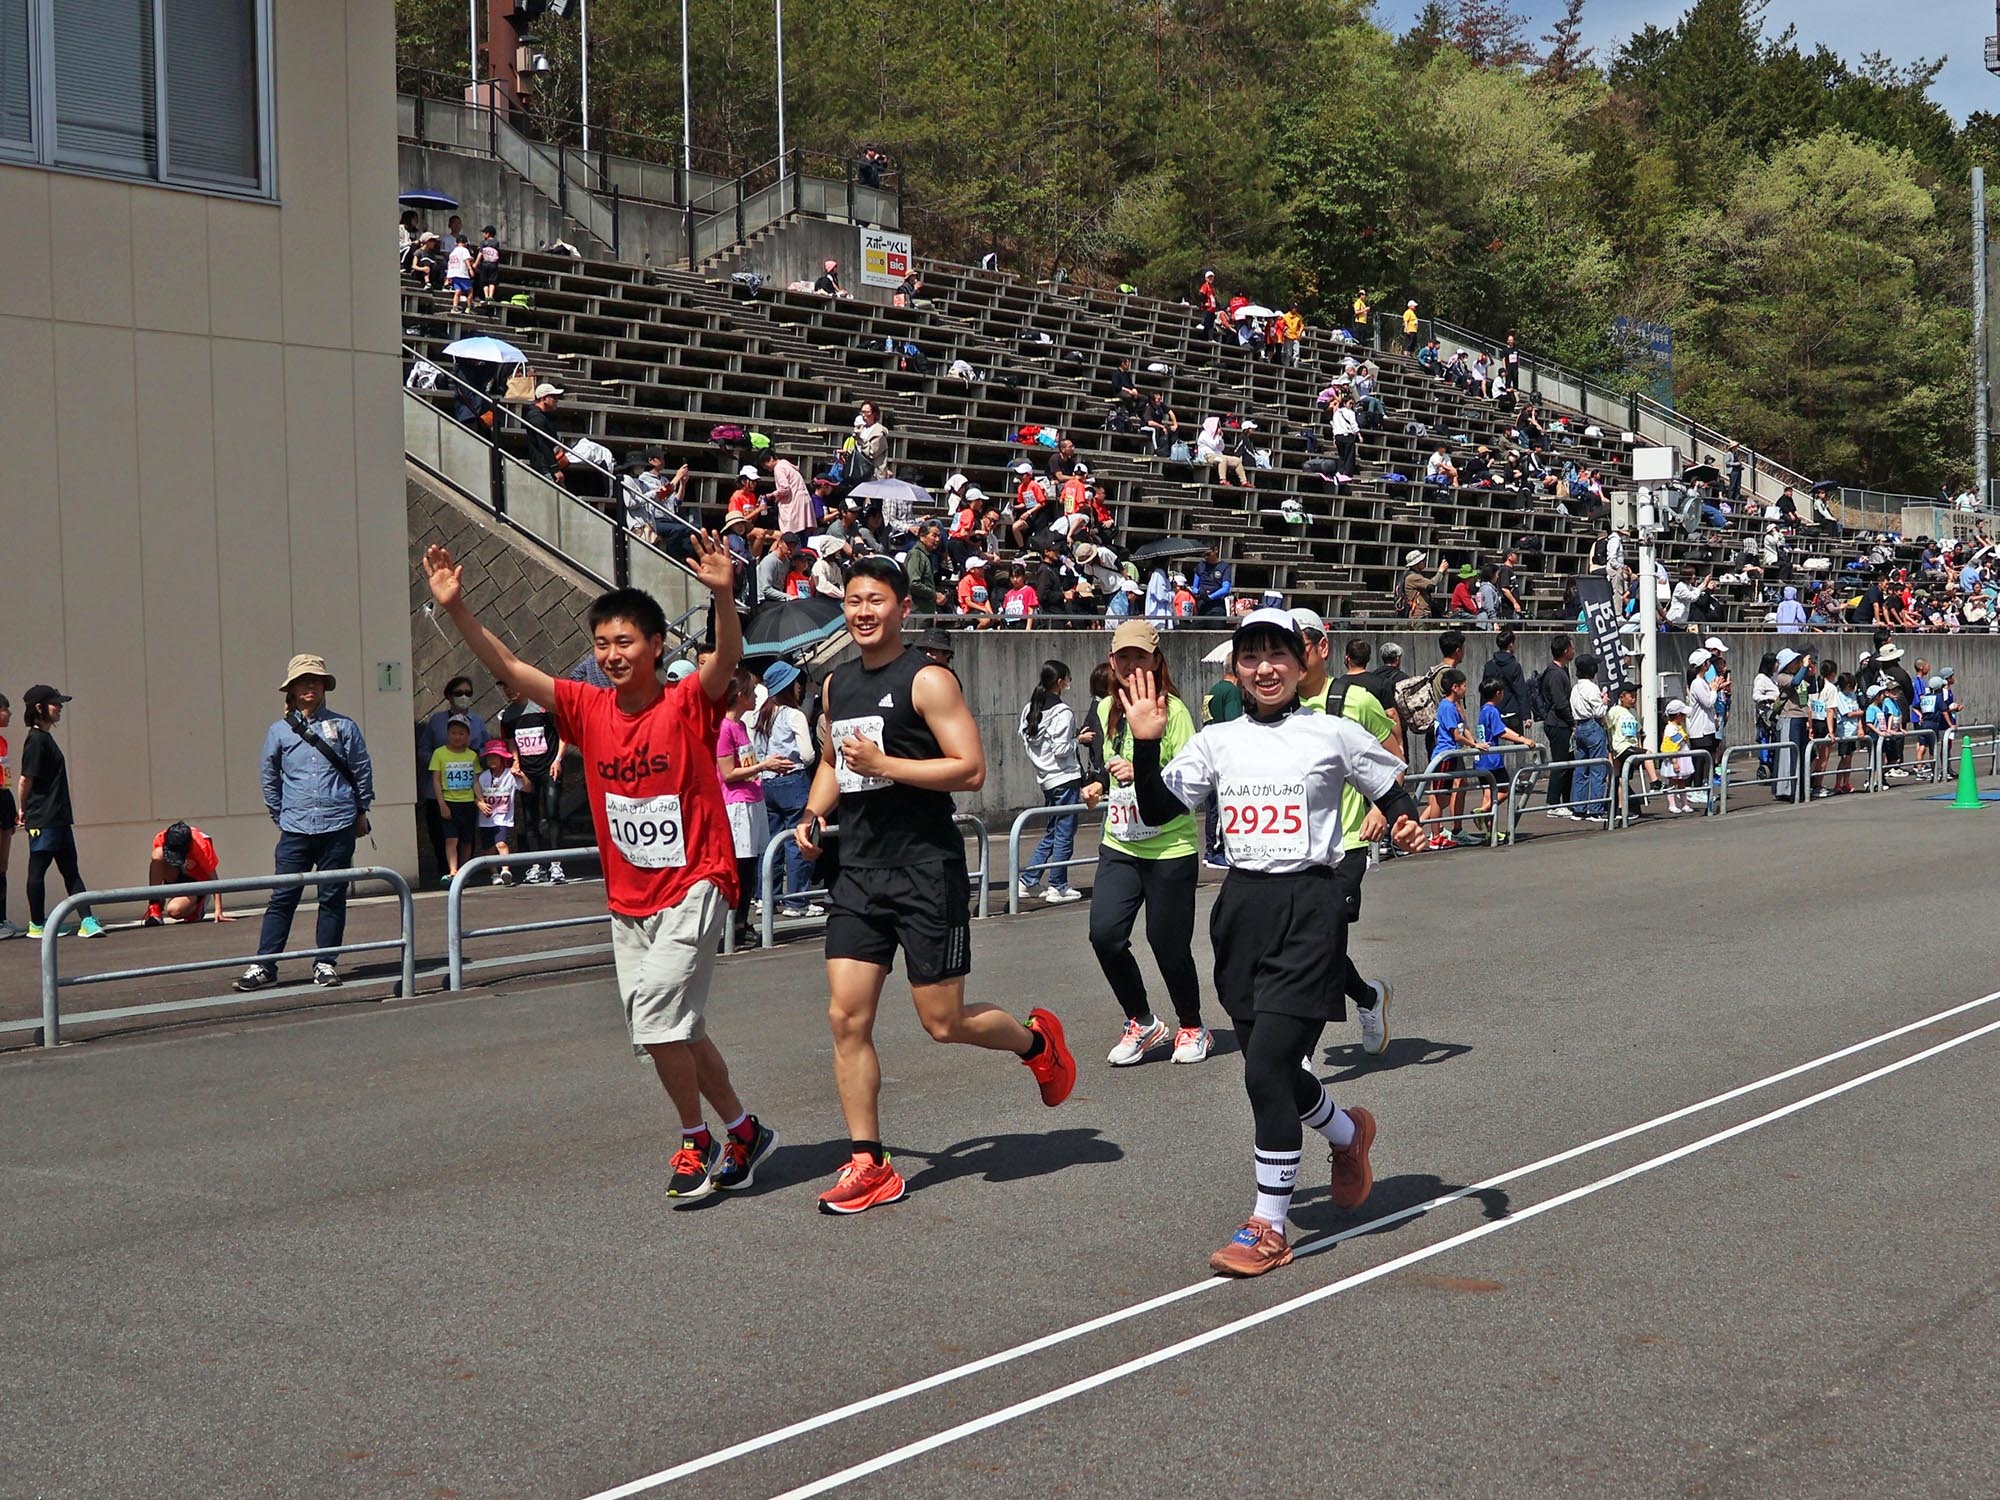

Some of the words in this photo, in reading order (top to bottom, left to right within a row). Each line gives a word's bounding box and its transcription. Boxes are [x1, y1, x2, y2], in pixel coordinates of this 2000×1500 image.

[865, 236, 908, 254] スポーツくじ
[517, 736, 543, 749] 5077
[447, 770, 474, 782] 4435
[1237, 783, 1304, 797] JAひがしみの
[1223, 804, 1303, 835] 2925
[611, 818, 679, 847] 1099
